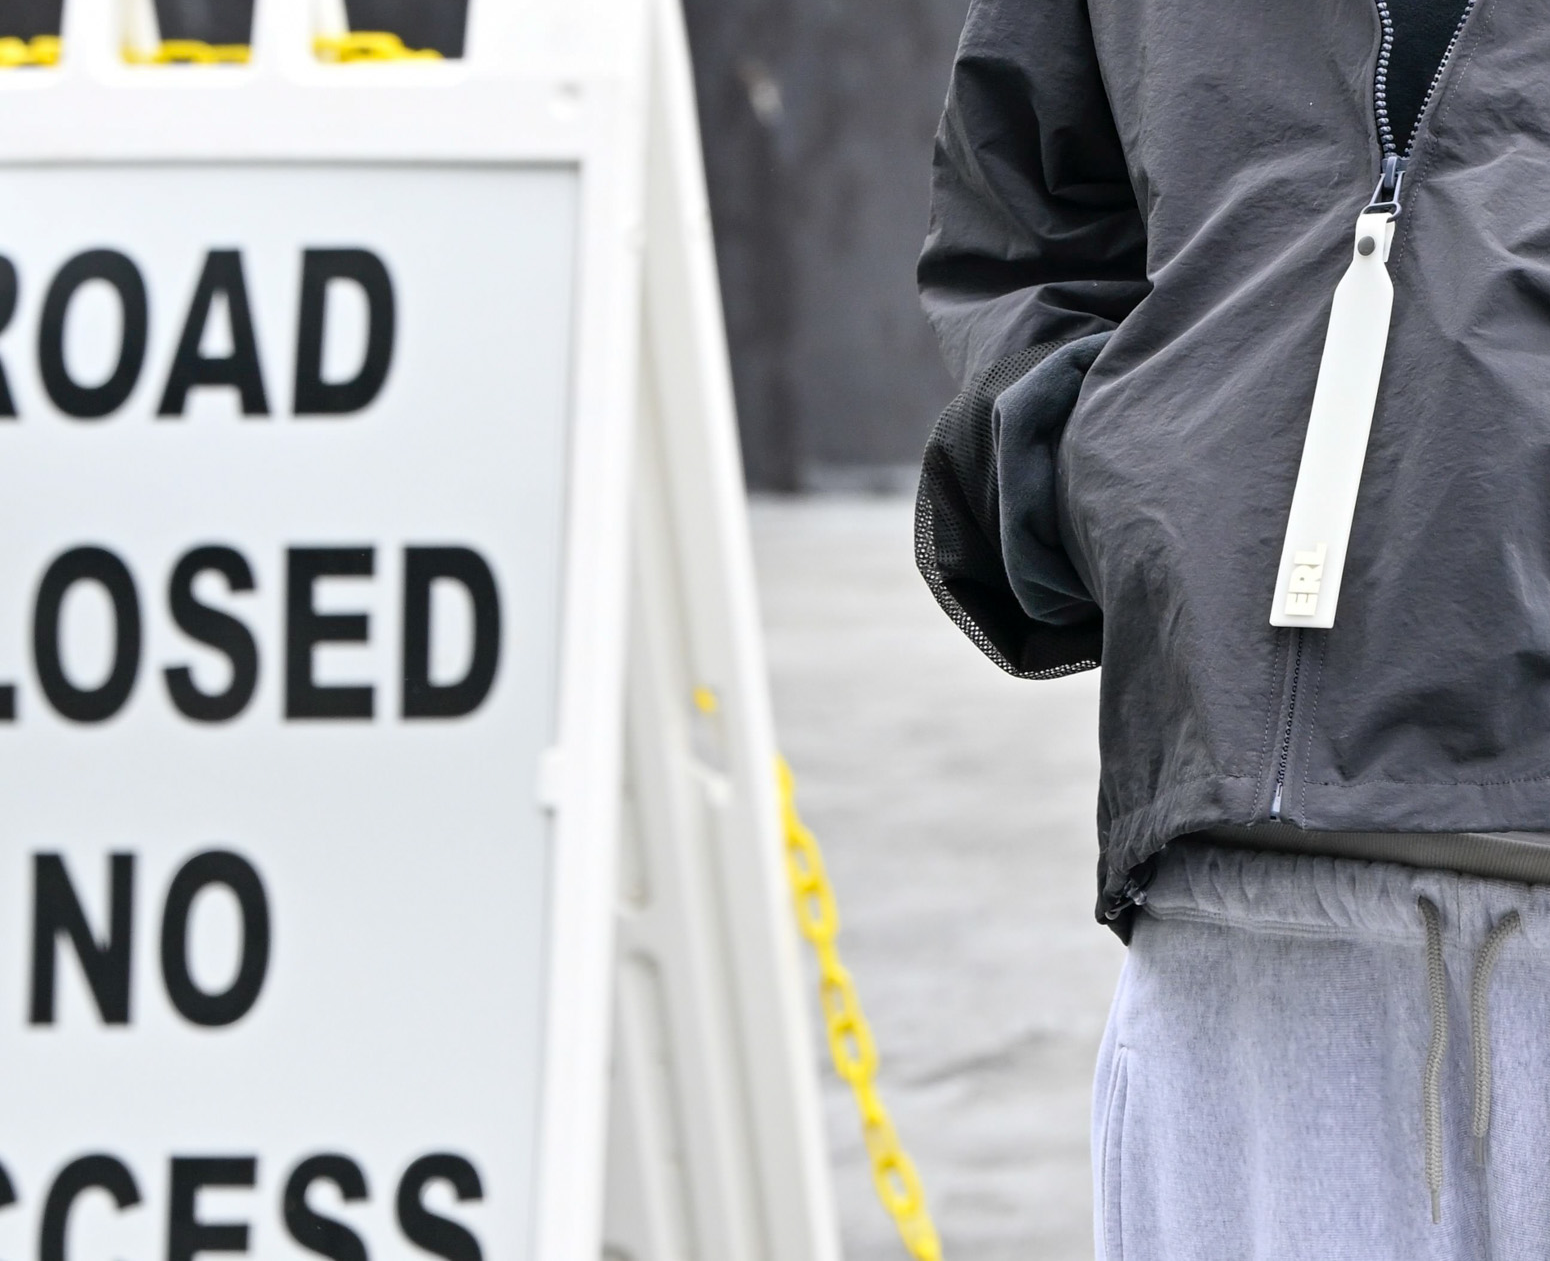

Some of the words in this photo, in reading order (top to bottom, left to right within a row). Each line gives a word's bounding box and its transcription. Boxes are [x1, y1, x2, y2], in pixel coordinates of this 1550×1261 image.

[0, 247, 397, 421] OAD
[0, 543, 503, 726] OSED
[1284, 542, 1328, 616] ERL
[27, 848, 272, 1029] NO
[0, 1151, 485, 1261] CESS
